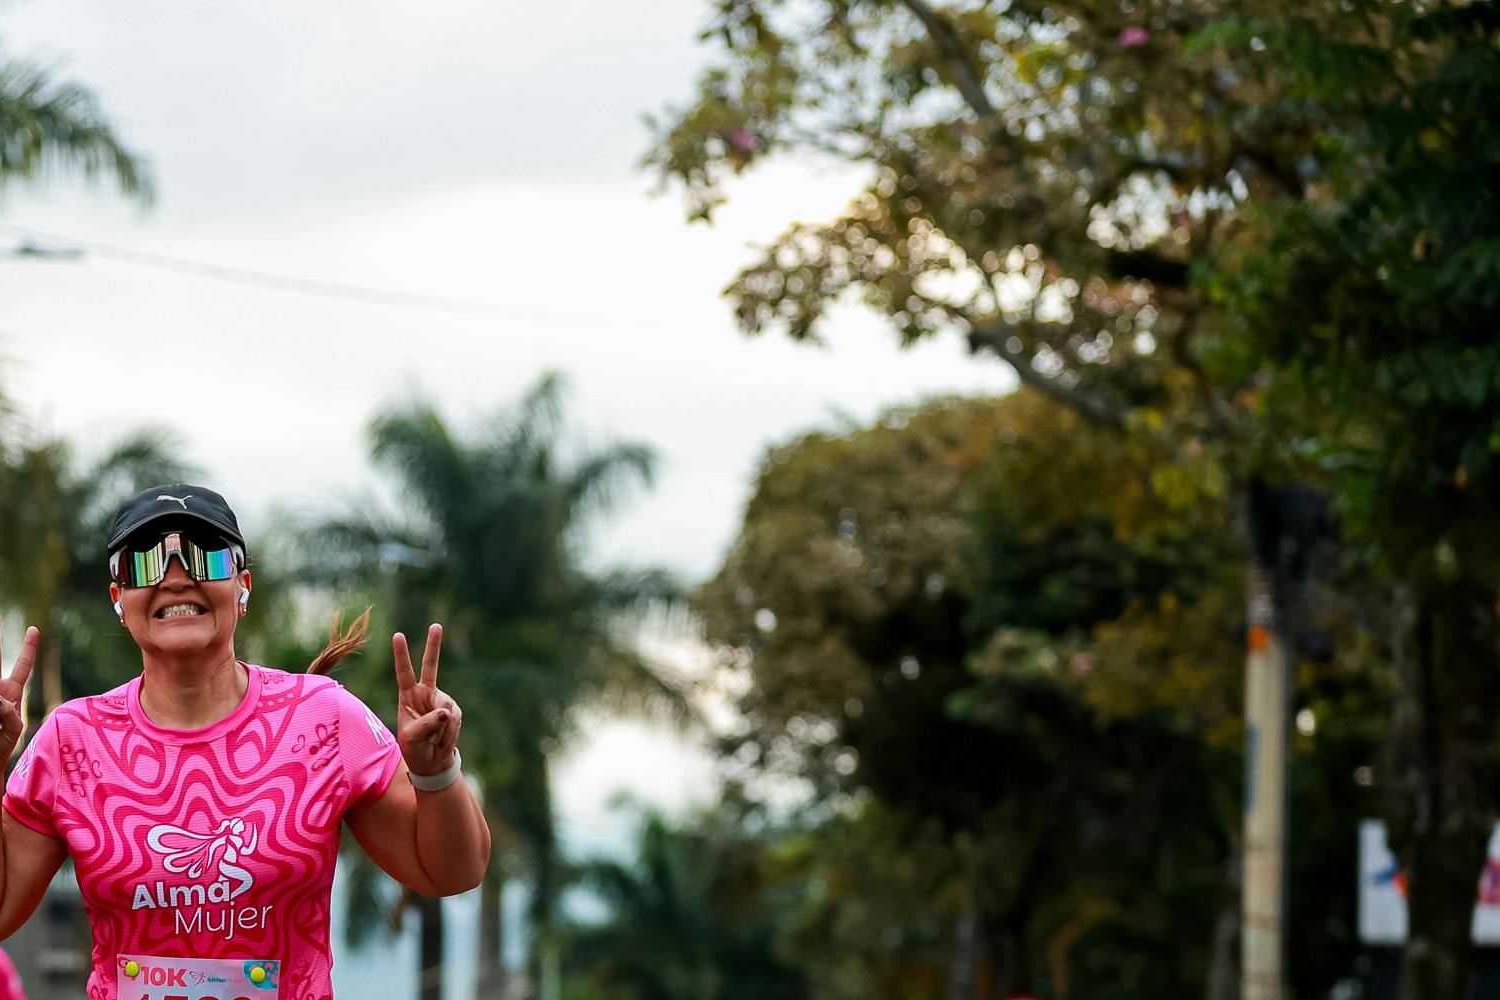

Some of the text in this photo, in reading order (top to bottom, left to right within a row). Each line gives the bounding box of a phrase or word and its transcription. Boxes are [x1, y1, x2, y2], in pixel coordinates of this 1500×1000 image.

[131, 881, 231, 910] Alma
[175, 901, 273, 940] Mujer
[141, 966, 188, 988] 10K
